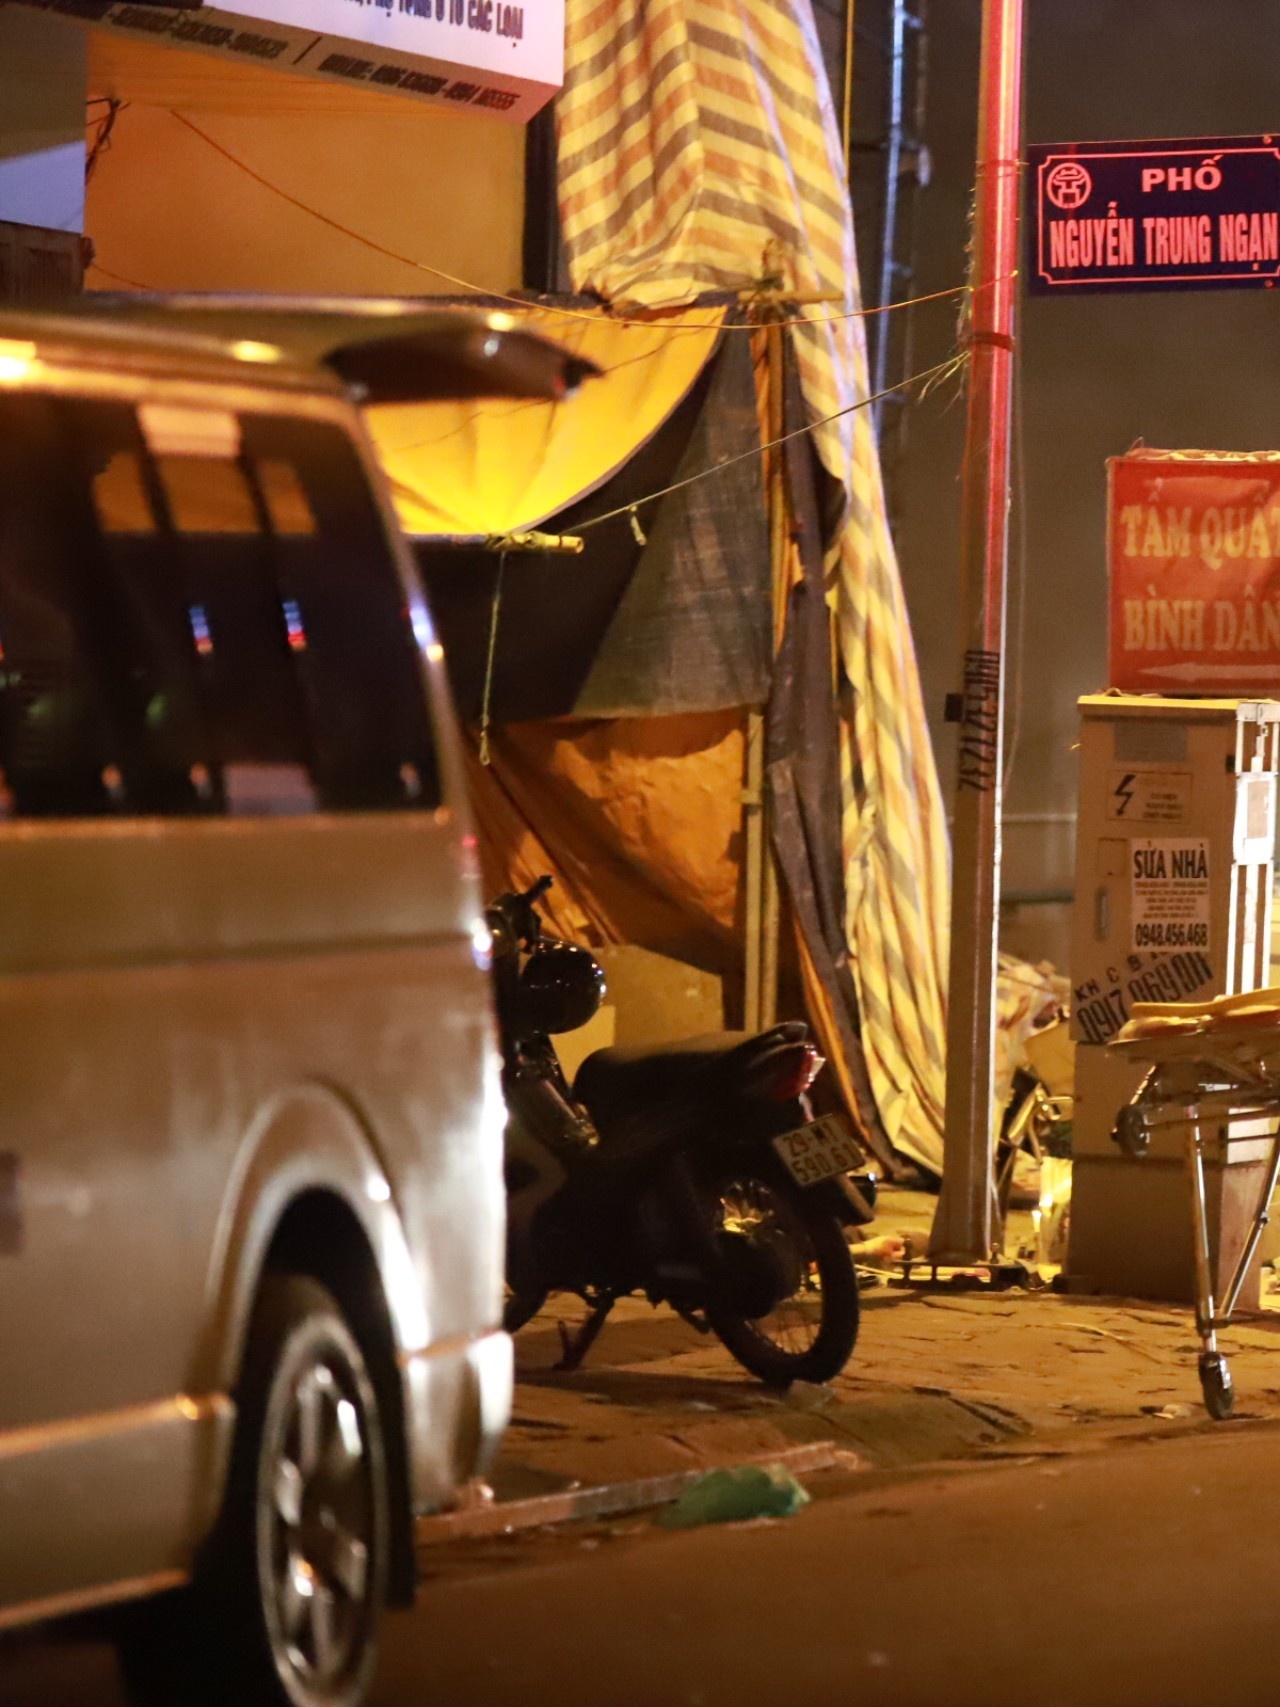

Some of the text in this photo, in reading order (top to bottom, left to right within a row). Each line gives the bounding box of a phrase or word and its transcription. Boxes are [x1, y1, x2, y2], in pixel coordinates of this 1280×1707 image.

[1142, 155, 1223, 193] PHỐ
[1050, 201, 1279, 271] NGUYỄN TRUNG NGẠN
[1123, 583, 1206, 651] BÌNH
[1134, 840, 1209, 879] SỬA NHÀ
